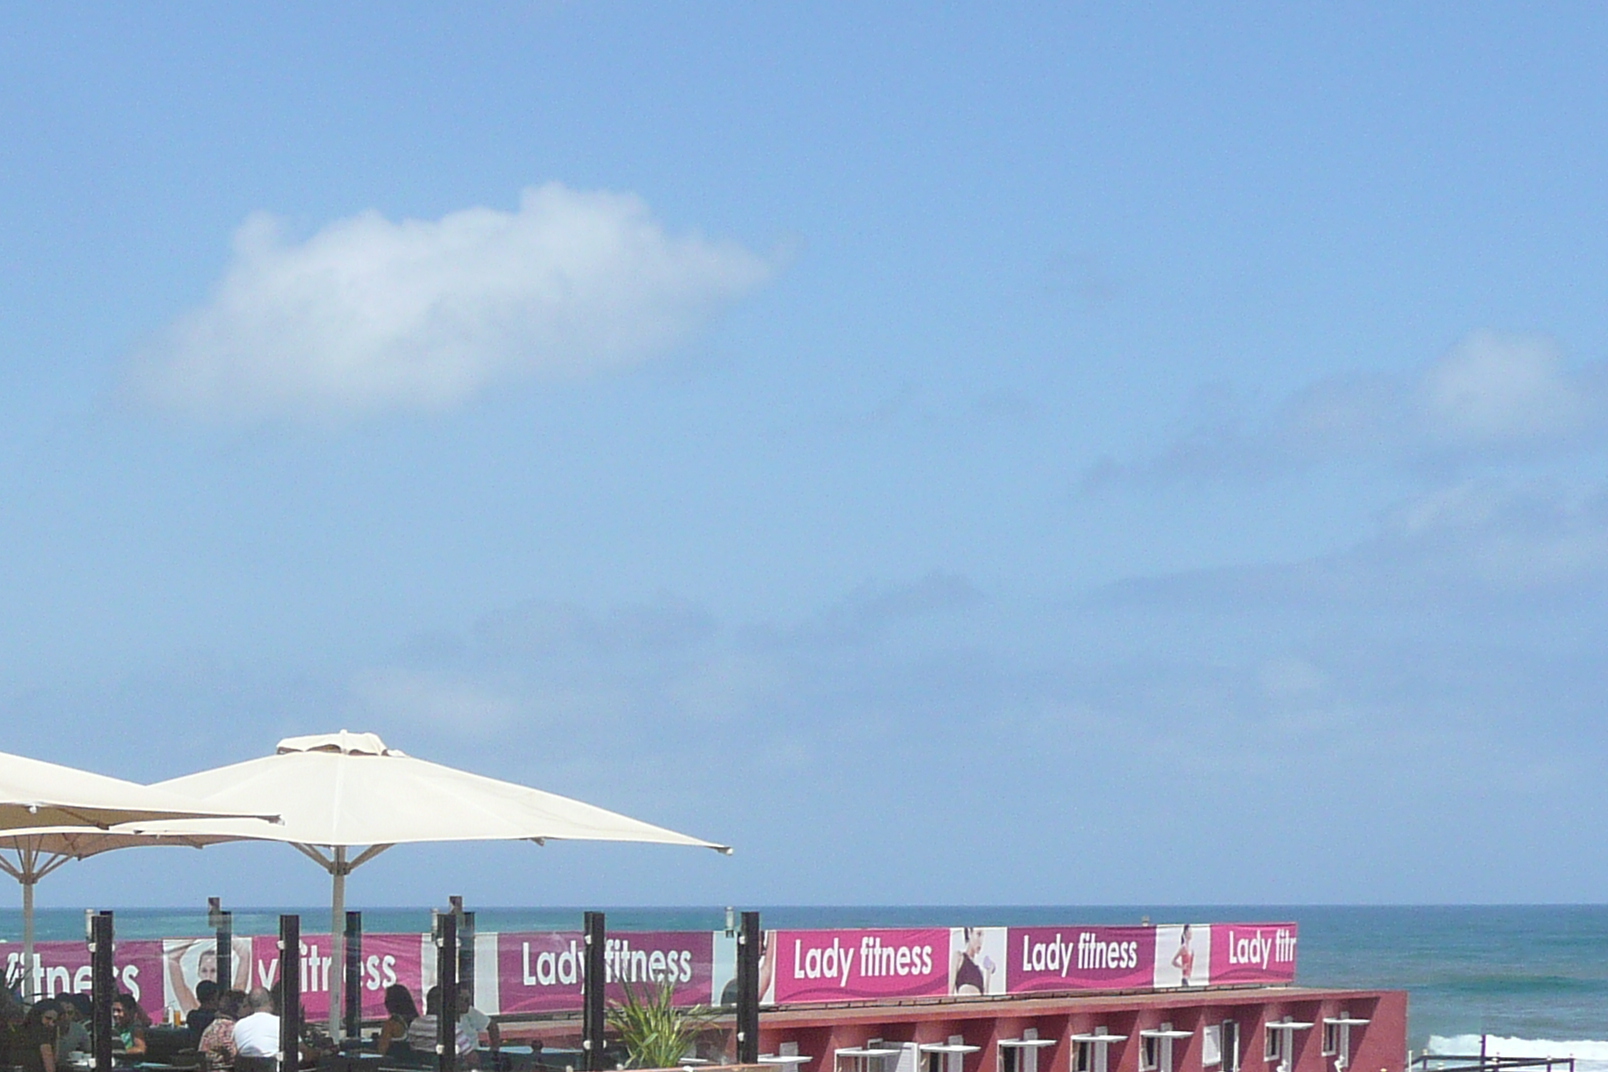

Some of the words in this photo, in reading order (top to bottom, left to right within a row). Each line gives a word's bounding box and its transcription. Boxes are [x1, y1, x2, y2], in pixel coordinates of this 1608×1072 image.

[604, 939, 691, 983] fitness
[793, 937, 854, 987] Lady
[860, 936, 932, 977] fitness
[1023, 933, 1073, 977] Lady
[1078, 933, 1137, 969] fitness
[1229, 930, 1272, 970] Lady
